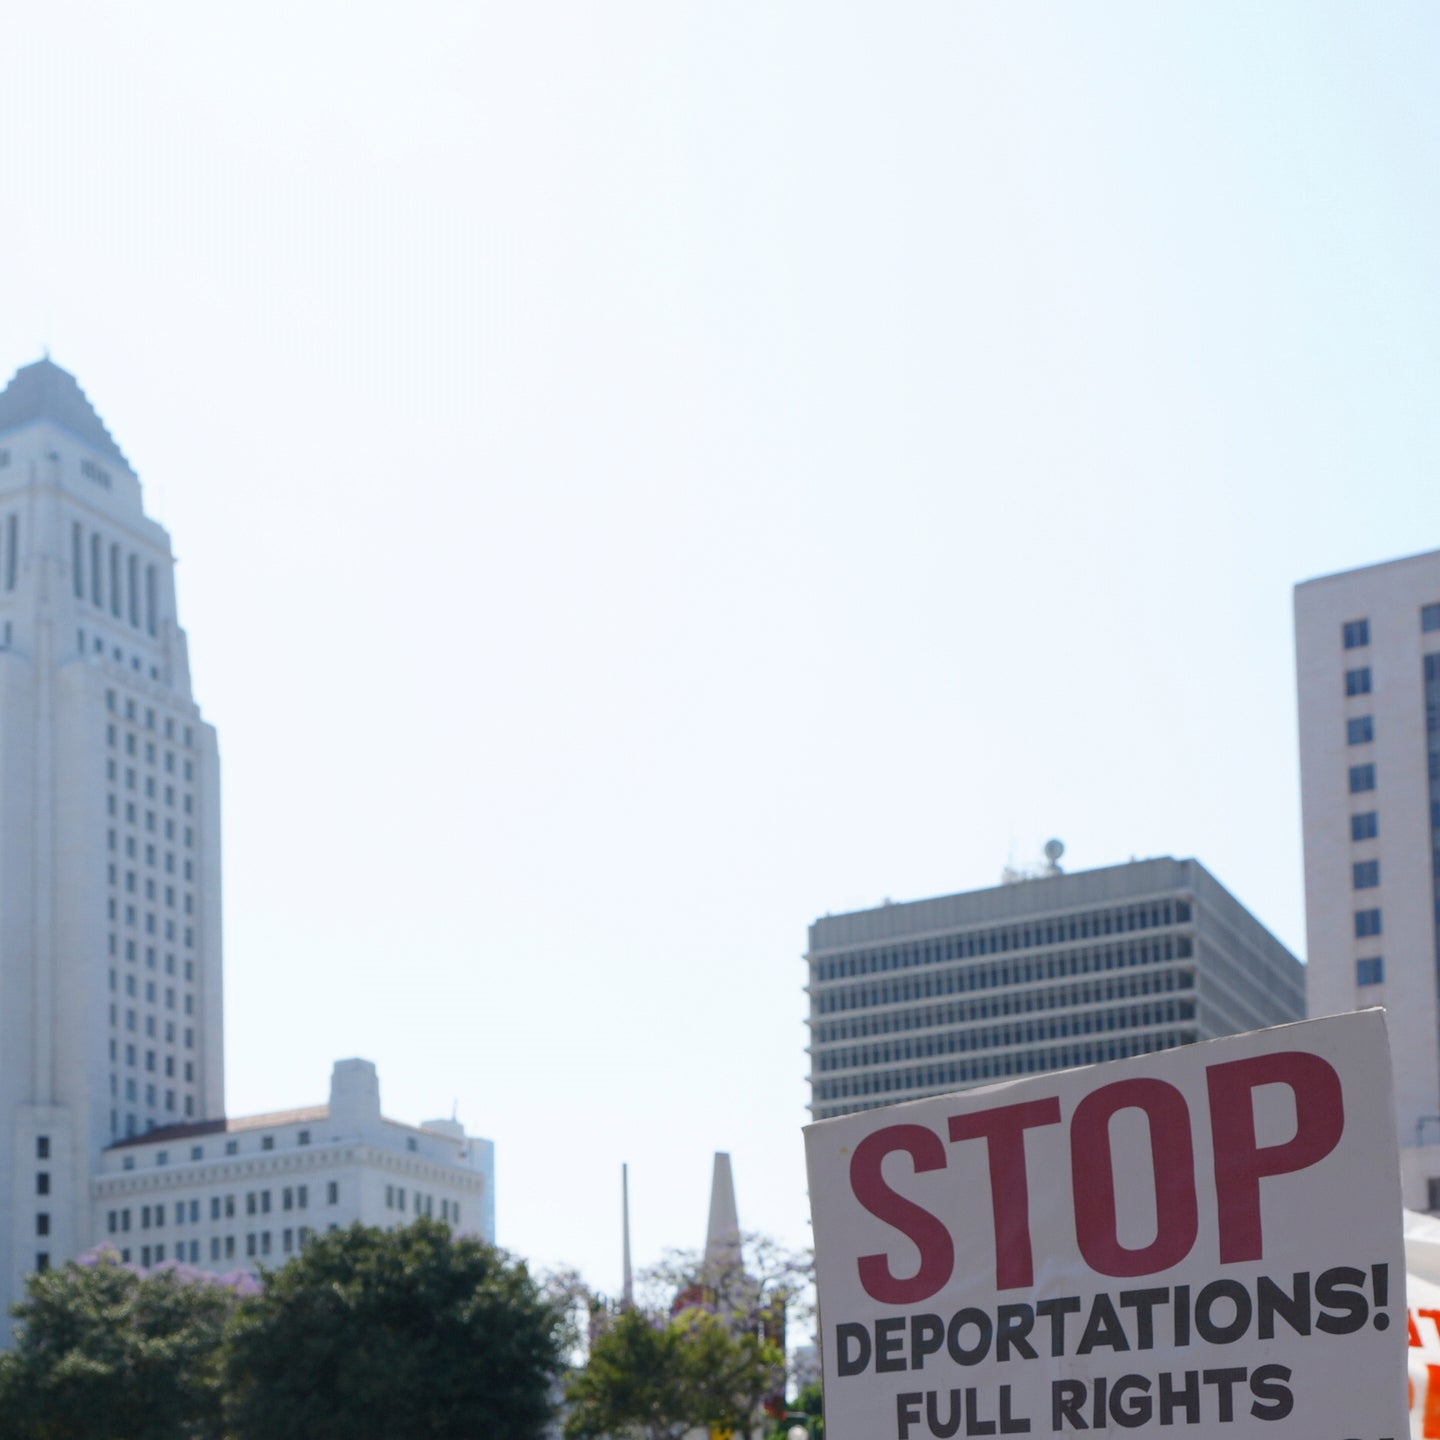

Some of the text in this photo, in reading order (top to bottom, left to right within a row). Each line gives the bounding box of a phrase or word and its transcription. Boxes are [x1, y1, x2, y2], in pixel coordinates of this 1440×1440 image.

[849, 1051, 1345, 1305] STOP
[836, 1263, 1389, 1377] DEPORTATIONS!
[896, 1364, 1294, 1440] FULL RIGHTS
